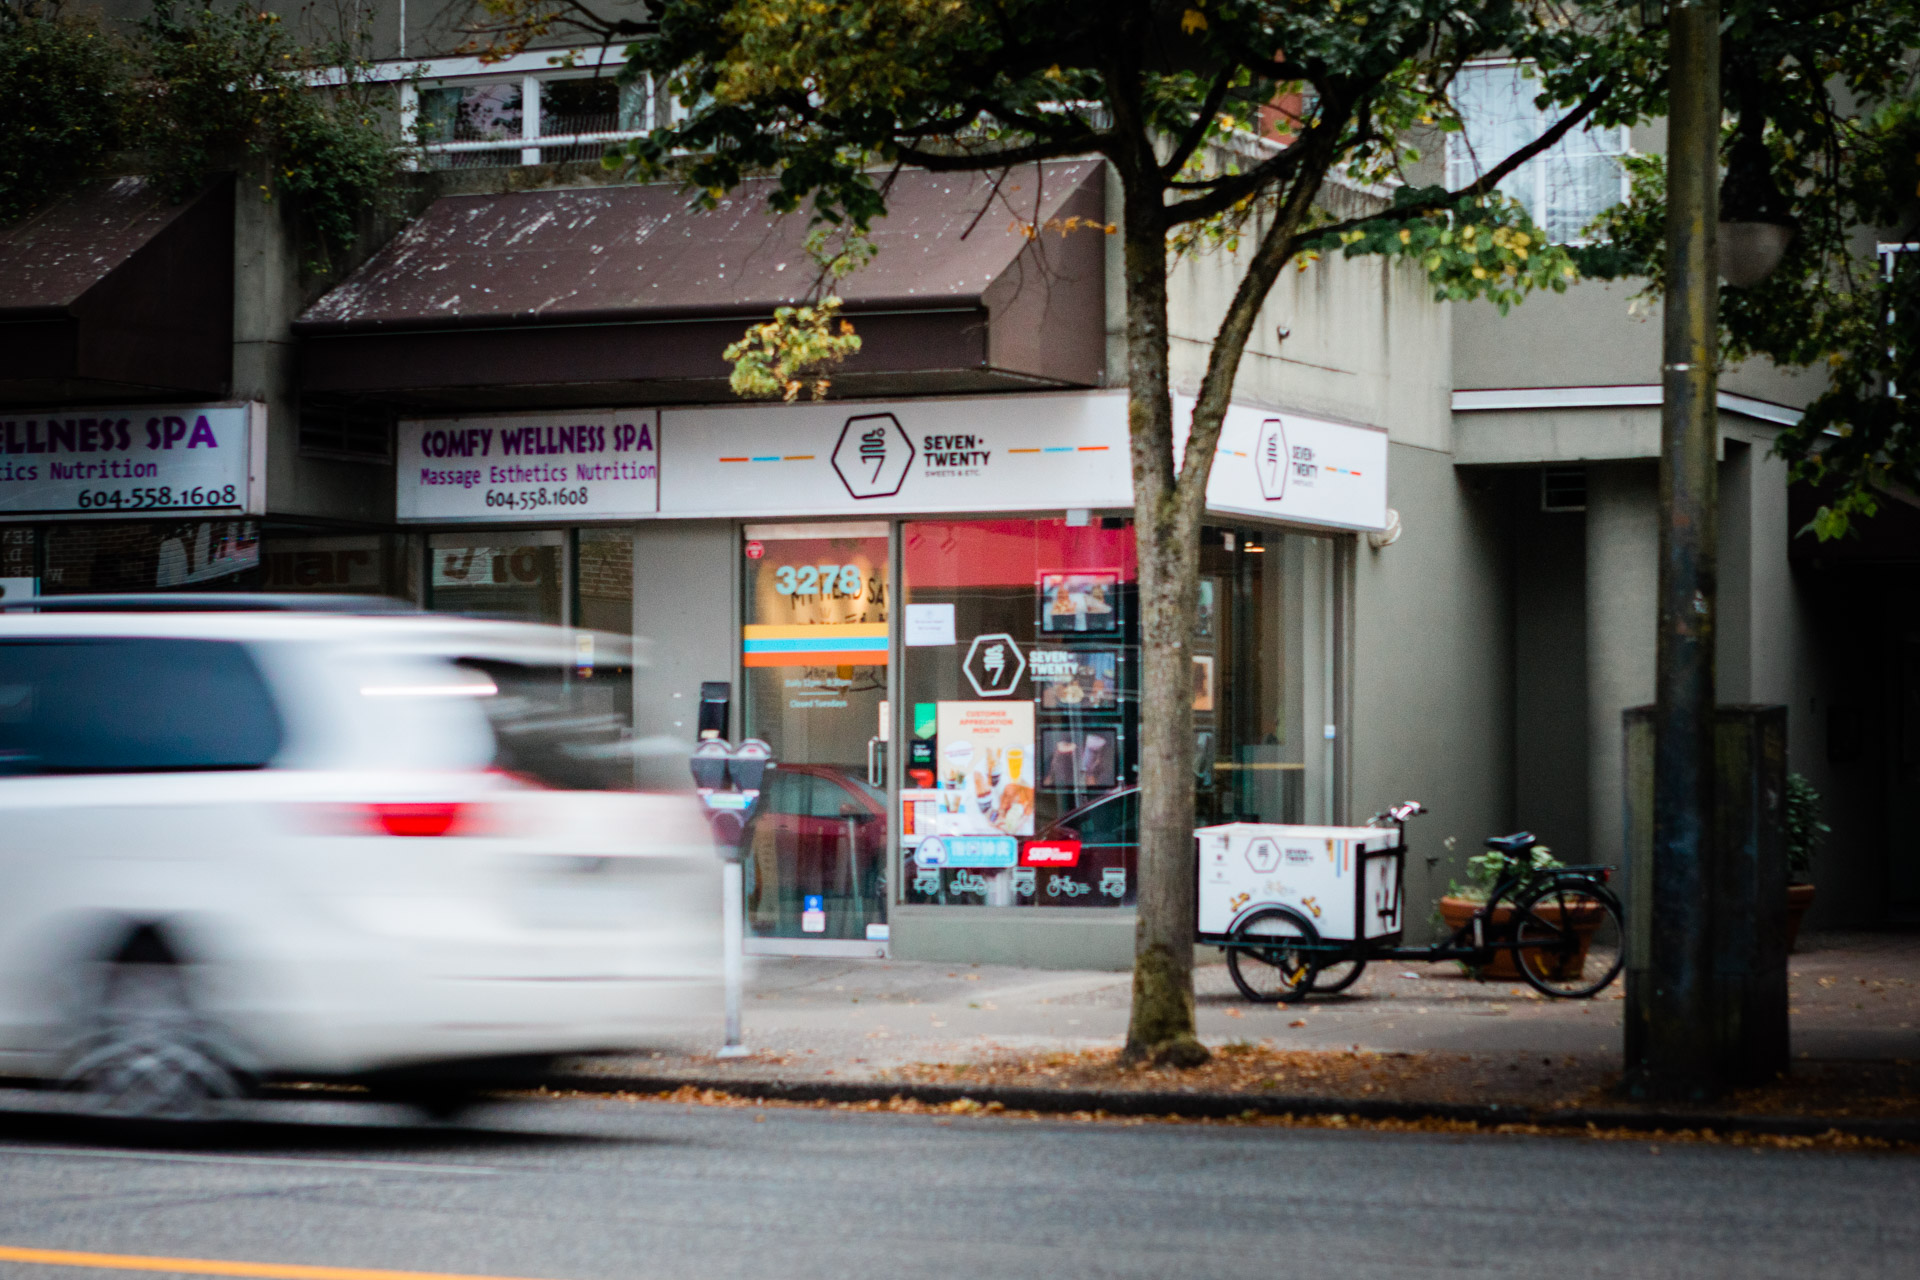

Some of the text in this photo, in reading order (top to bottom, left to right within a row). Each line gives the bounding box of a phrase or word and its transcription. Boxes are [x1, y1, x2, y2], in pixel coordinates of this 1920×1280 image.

[0, 415, 219, 454] LLNESS SPA
[421, 423, 653, 458] COMFY WELLNESS SPA
[0, 459, 158, 481] ics Nutrition
[923, 451, 991, 467] TWENTY
[420, 460, 657, 488] Massage Esthetics Nutrition
[486, 486, 589, 510] 604.558.1608
[775, 564, 861, 595] 3278
[1029, 662, 1078, 675] TWENTY
